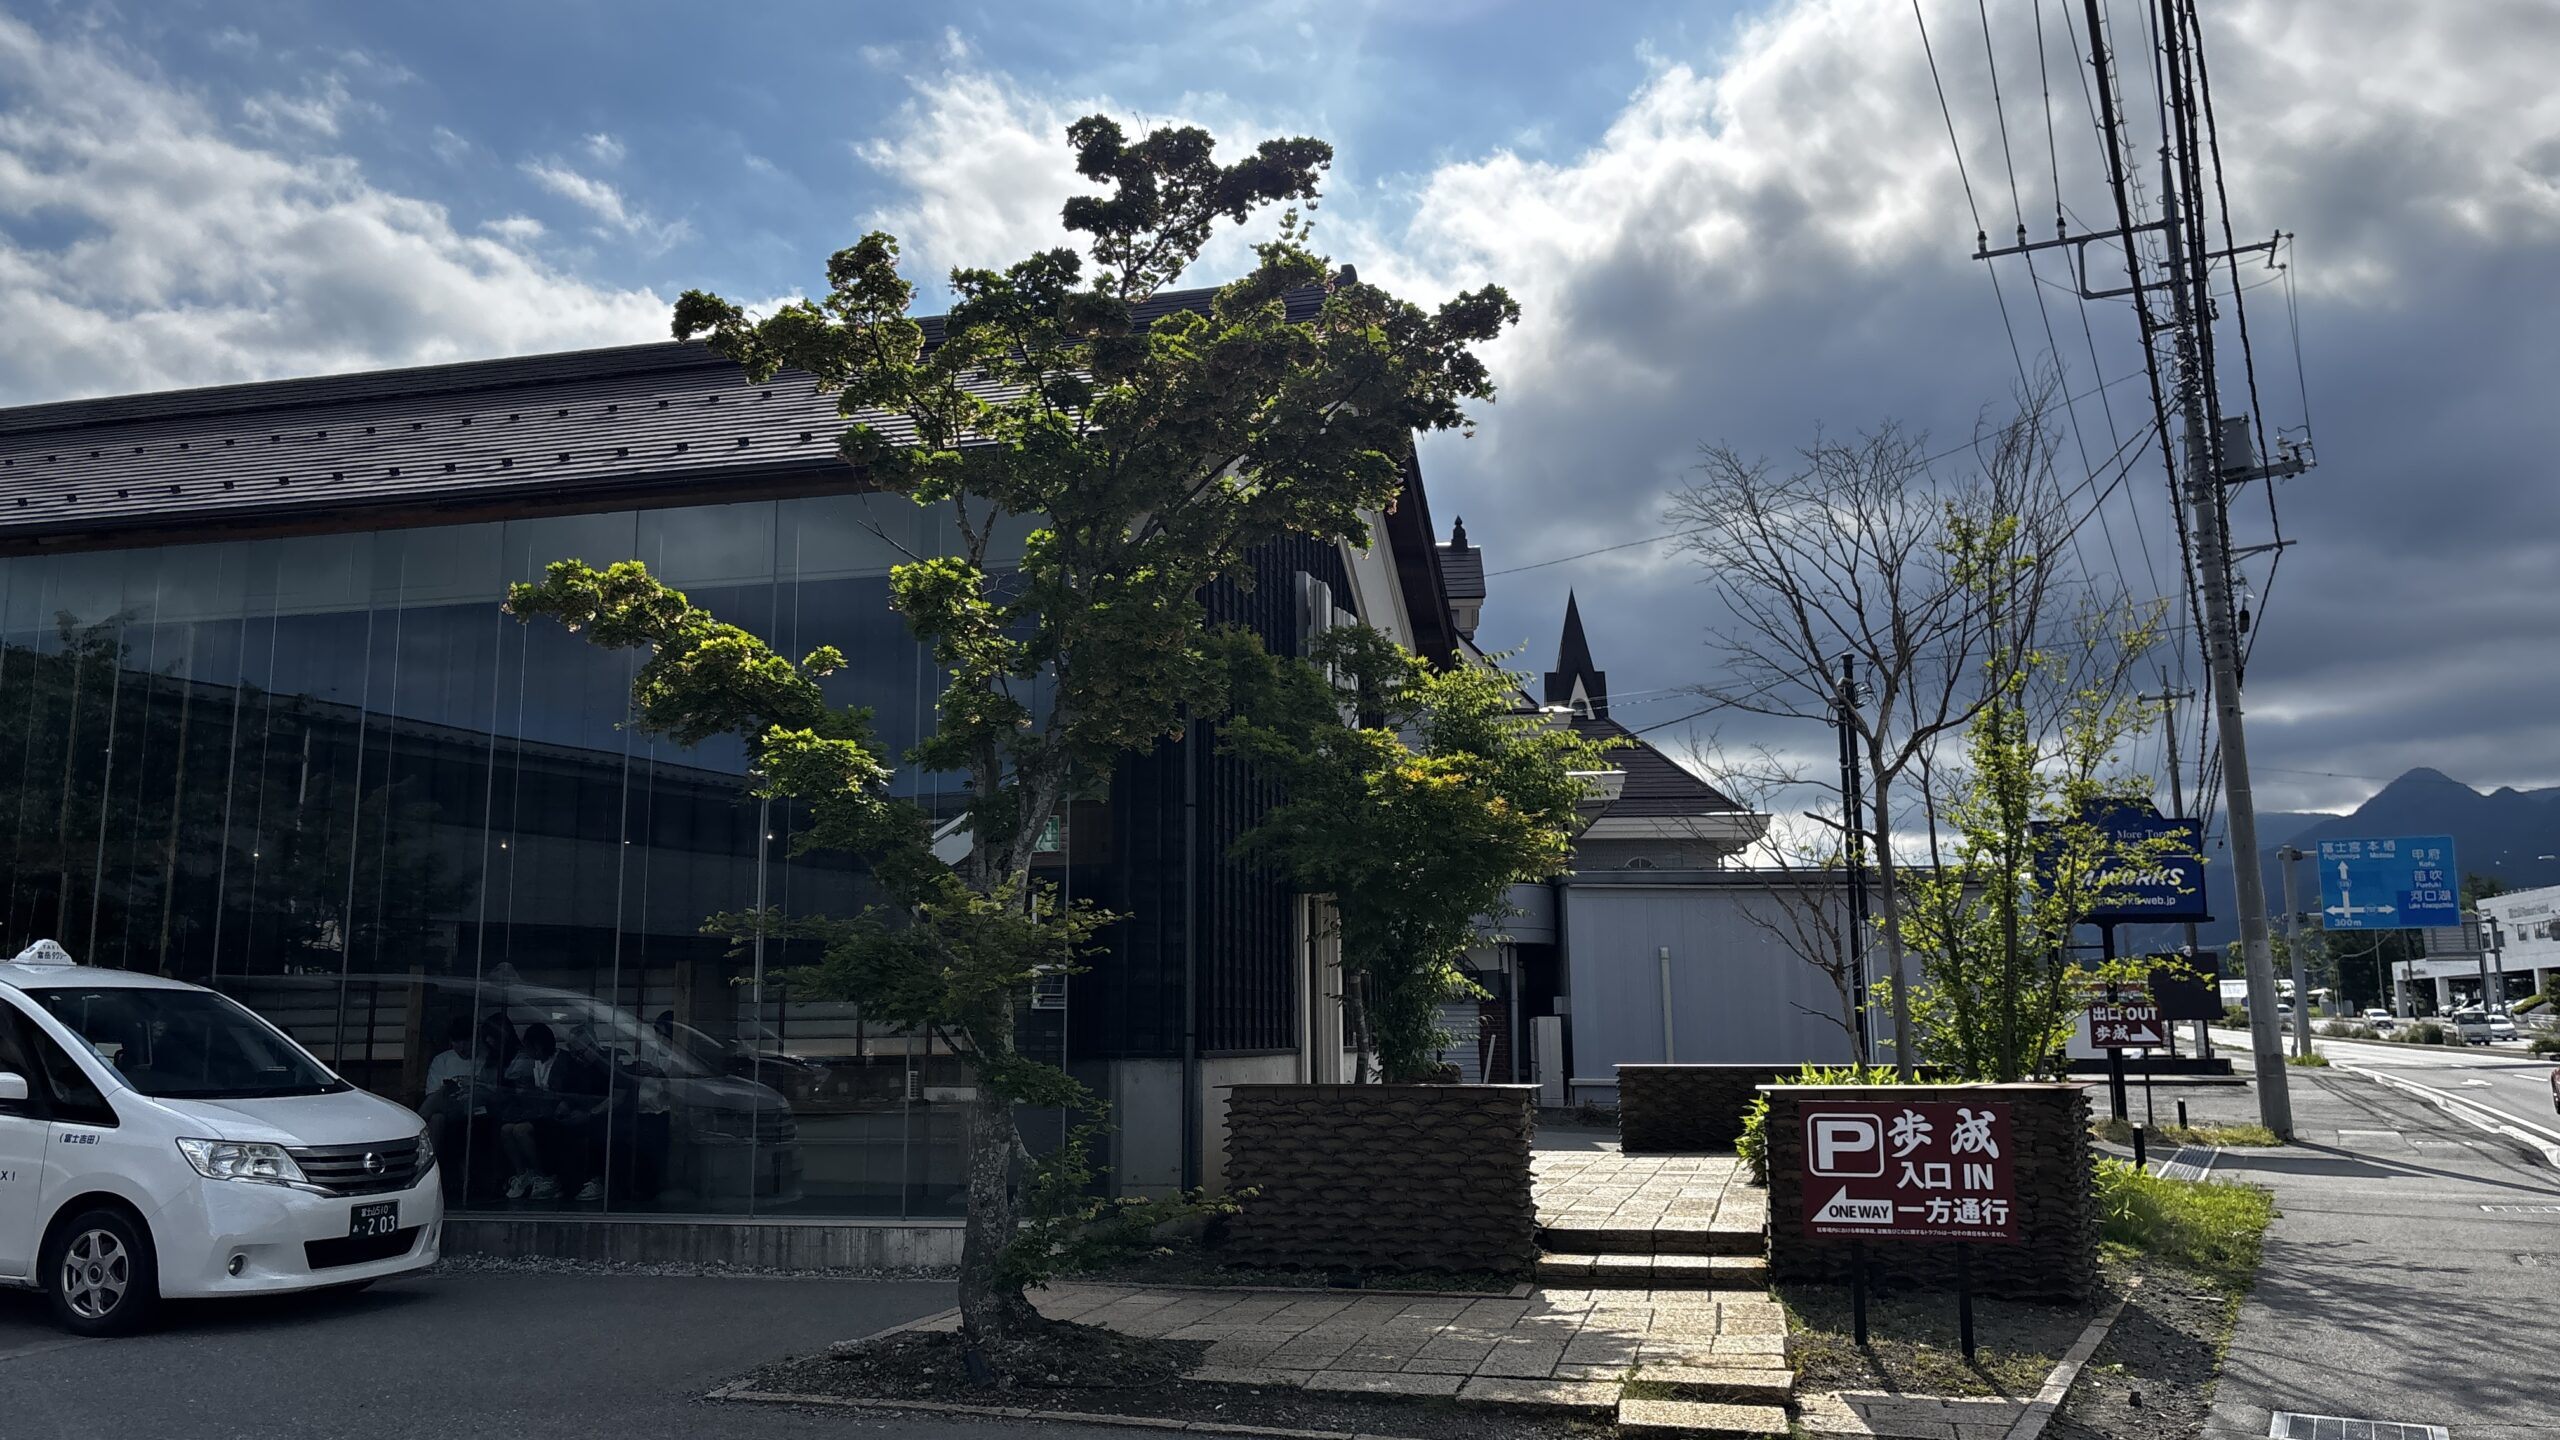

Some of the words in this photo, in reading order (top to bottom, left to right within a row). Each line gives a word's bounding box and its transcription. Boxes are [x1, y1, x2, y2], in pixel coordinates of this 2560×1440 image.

[2321, 842, 2361, 853] 富士宮
[2411, 848, 2441, 860] 甲府
[2413, 870, 2443, 881] 笛吹
[2410, 890, 2452, 902] 河口湖
[2092, 1006, 2122, 1021] 出口
[2126, 1007, 2158, 1020] OUT
[59, 1133, 101, 1145] (富士吉田)
[1817, 1120, 1876, 1170] P
[1896, 1162, 1952, 1190] 入口
[1963, 1163, 1994, 1190] IN
[1898, 1196, 2010, 1225] 一方通行
